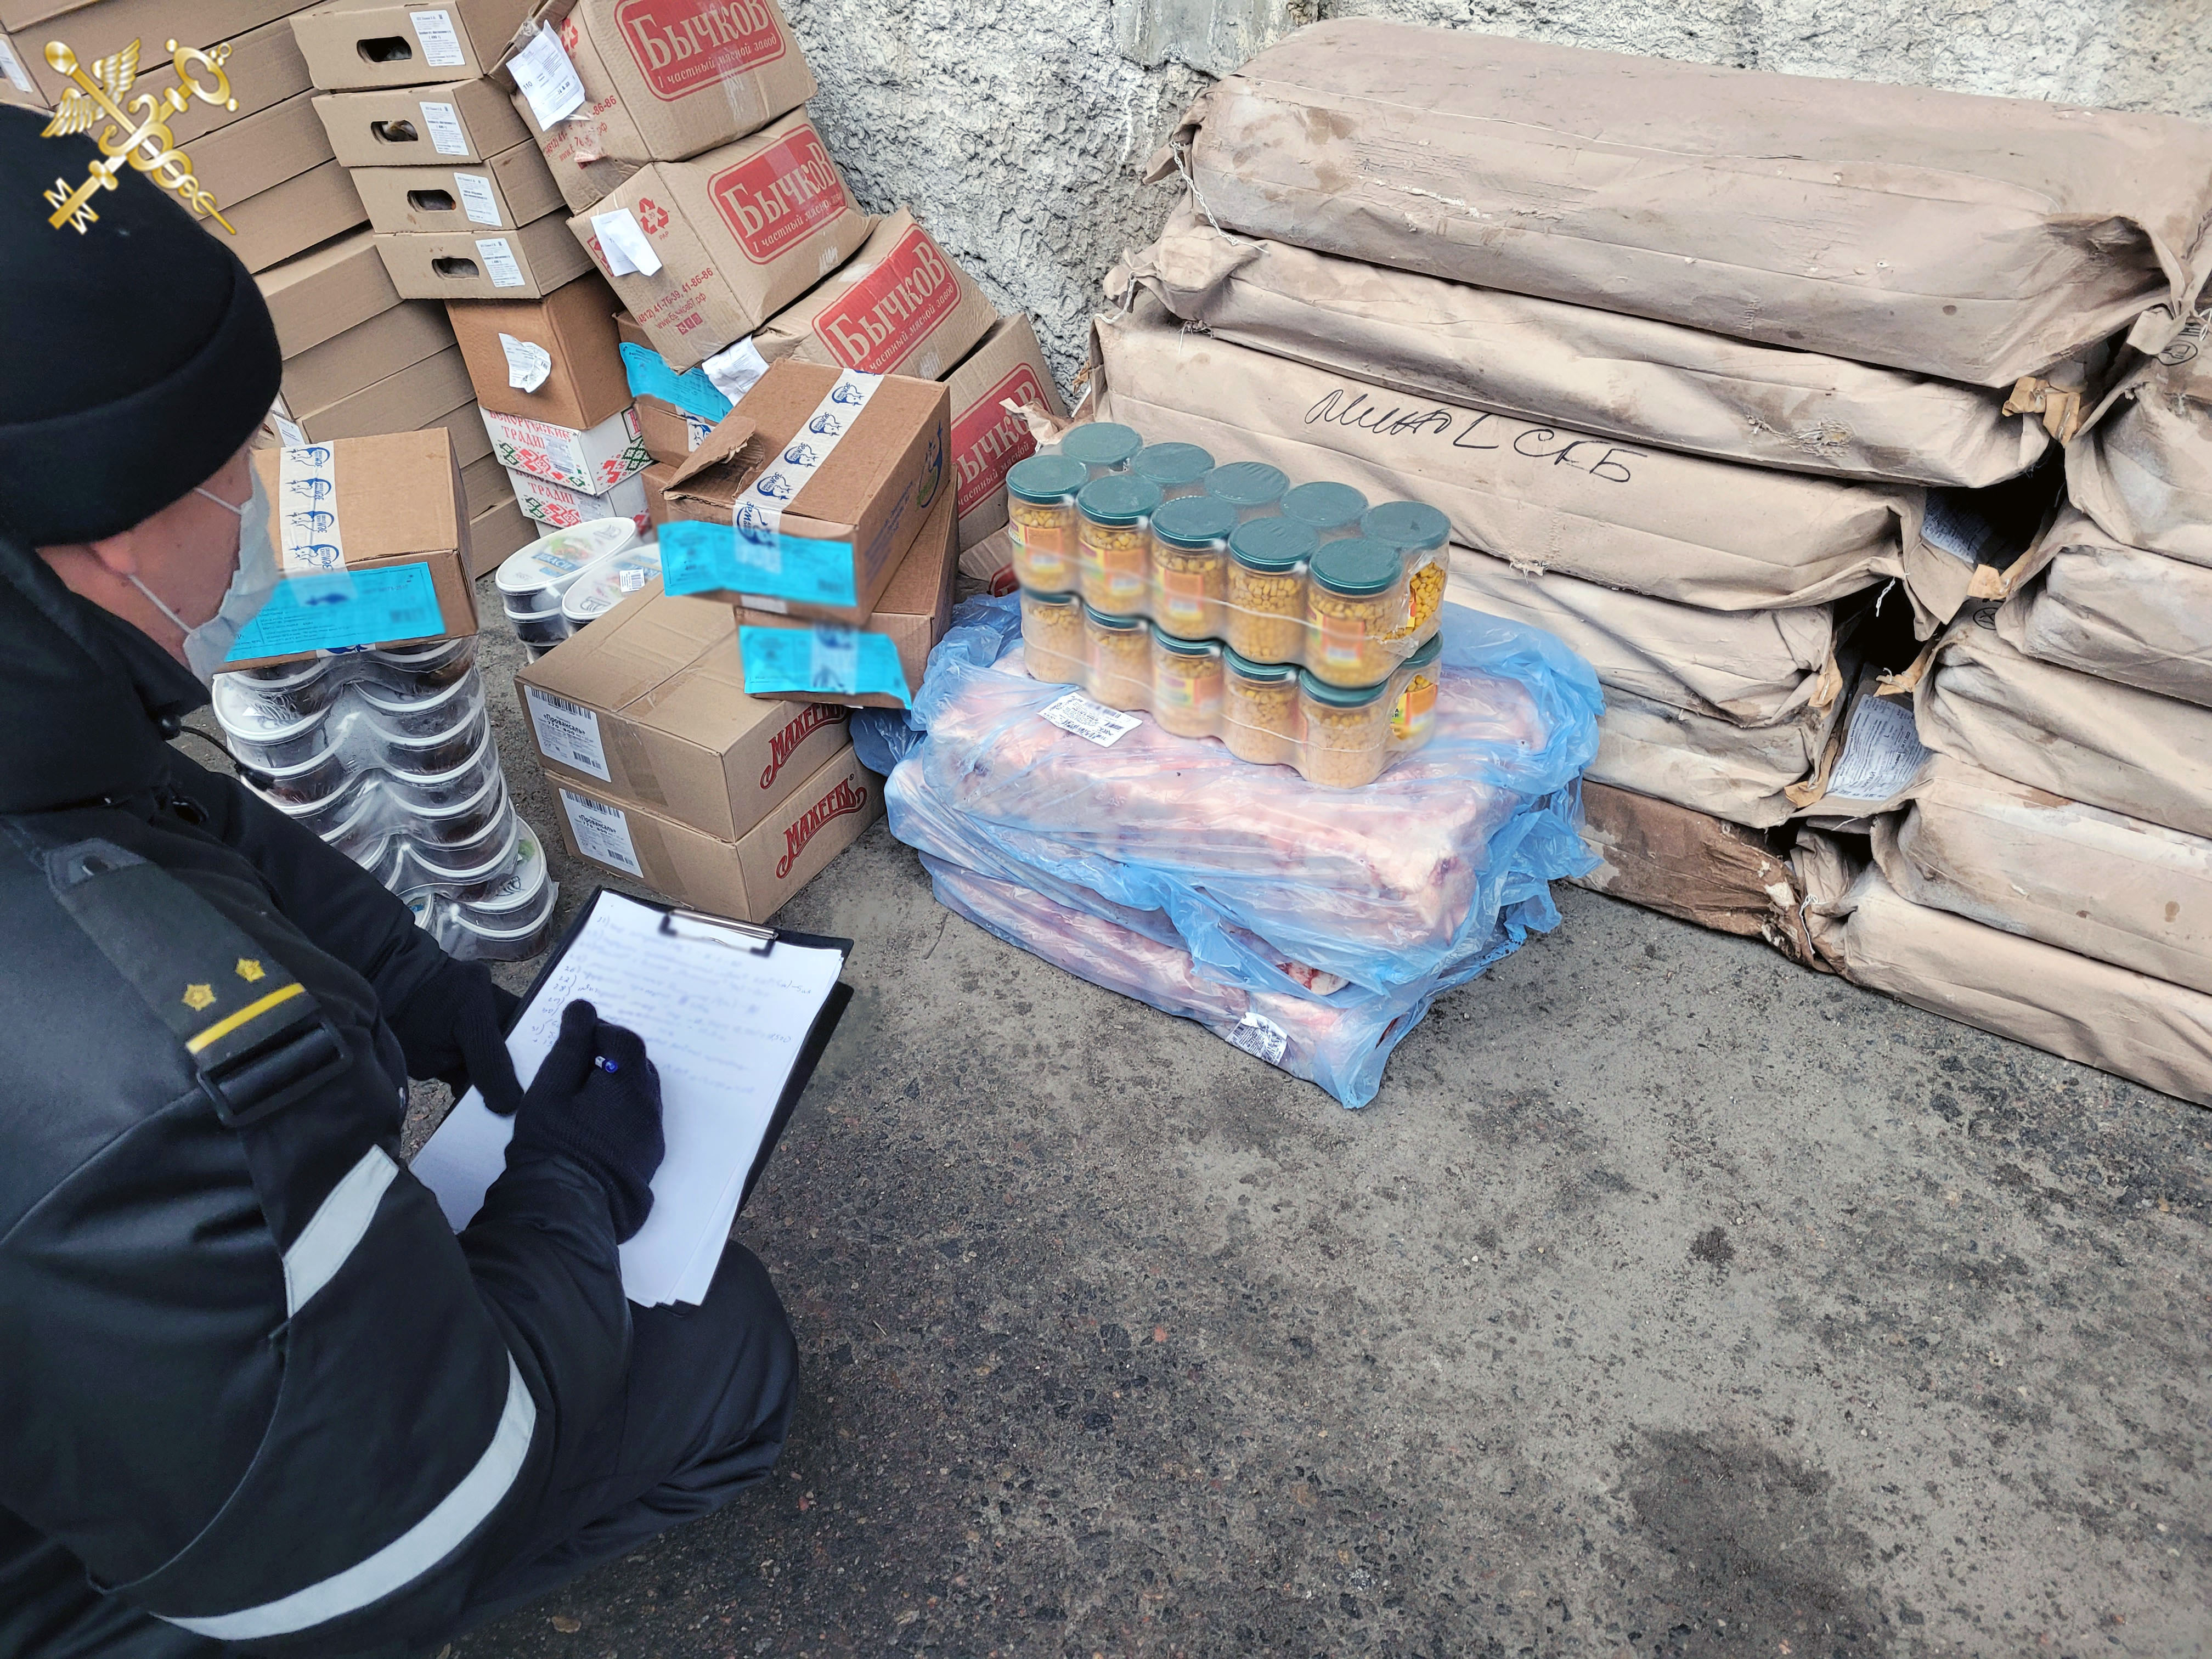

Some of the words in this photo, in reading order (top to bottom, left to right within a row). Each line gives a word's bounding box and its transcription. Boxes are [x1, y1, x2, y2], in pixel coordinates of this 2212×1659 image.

[667, 58, 715, 84] частный
[718, 43, 751, 66] мясной
[754, 33, 776, 53] завод
[523, 81, 533, 90] 110
[592, 95, 617, 115] -86-86
[659, 231, 669, 241] PAP
[761, 215, 804, 247] частный
[637, 309, 656, 326] (4812)
[681, 268, 713, 293] 41-86-86
[870, 331, 909, 370] частный
[910, 303, 935, 336] мясной
[937, 282, 953, 307] завод
[501, 426, 545, 449] ТРАДИ
[528, 482, 575, 505] ТРАДИ
